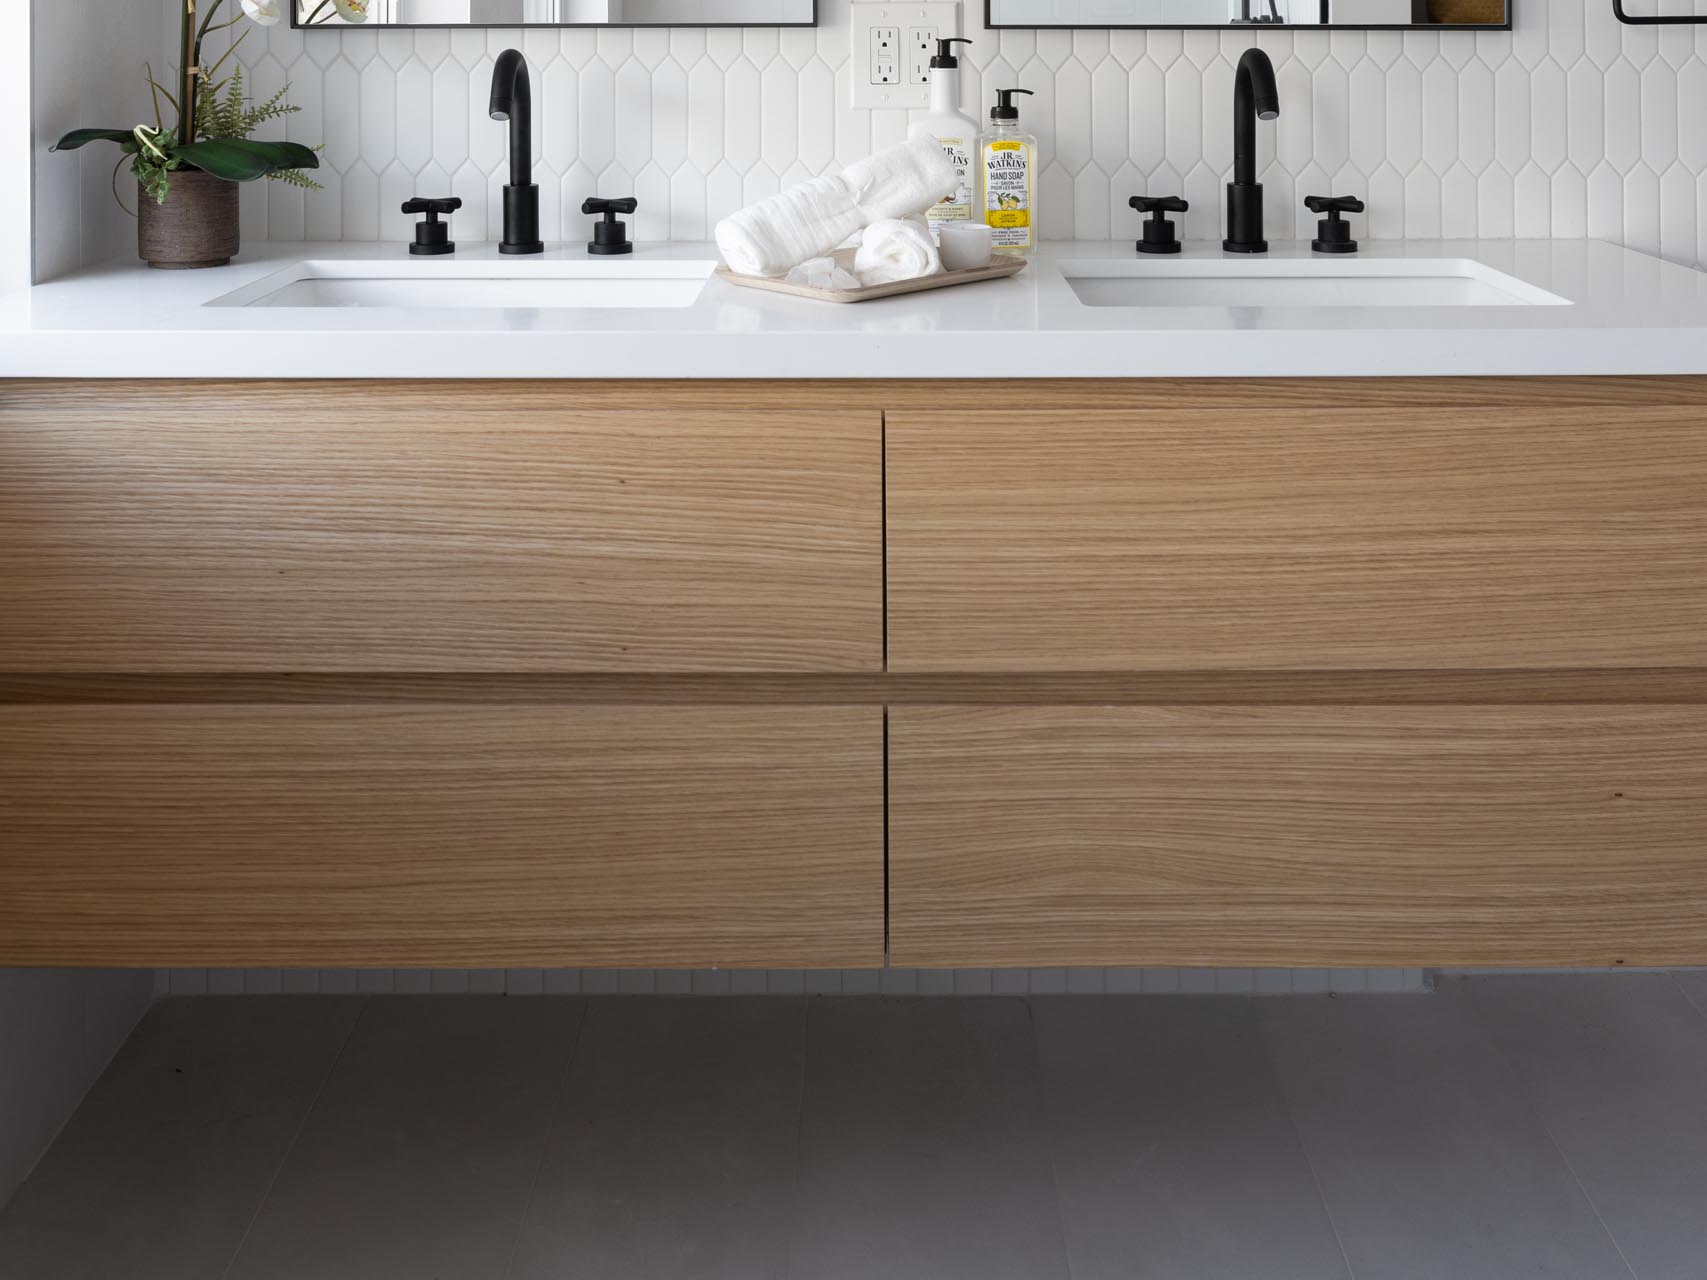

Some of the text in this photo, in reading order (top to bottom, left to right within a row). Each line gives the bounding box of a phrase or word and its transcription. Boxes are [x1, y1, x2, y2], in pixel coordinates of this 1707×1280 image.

[987, 160, 1027, 169] WATKINS
[991, 171, 1024, 181] HAND SOAP
